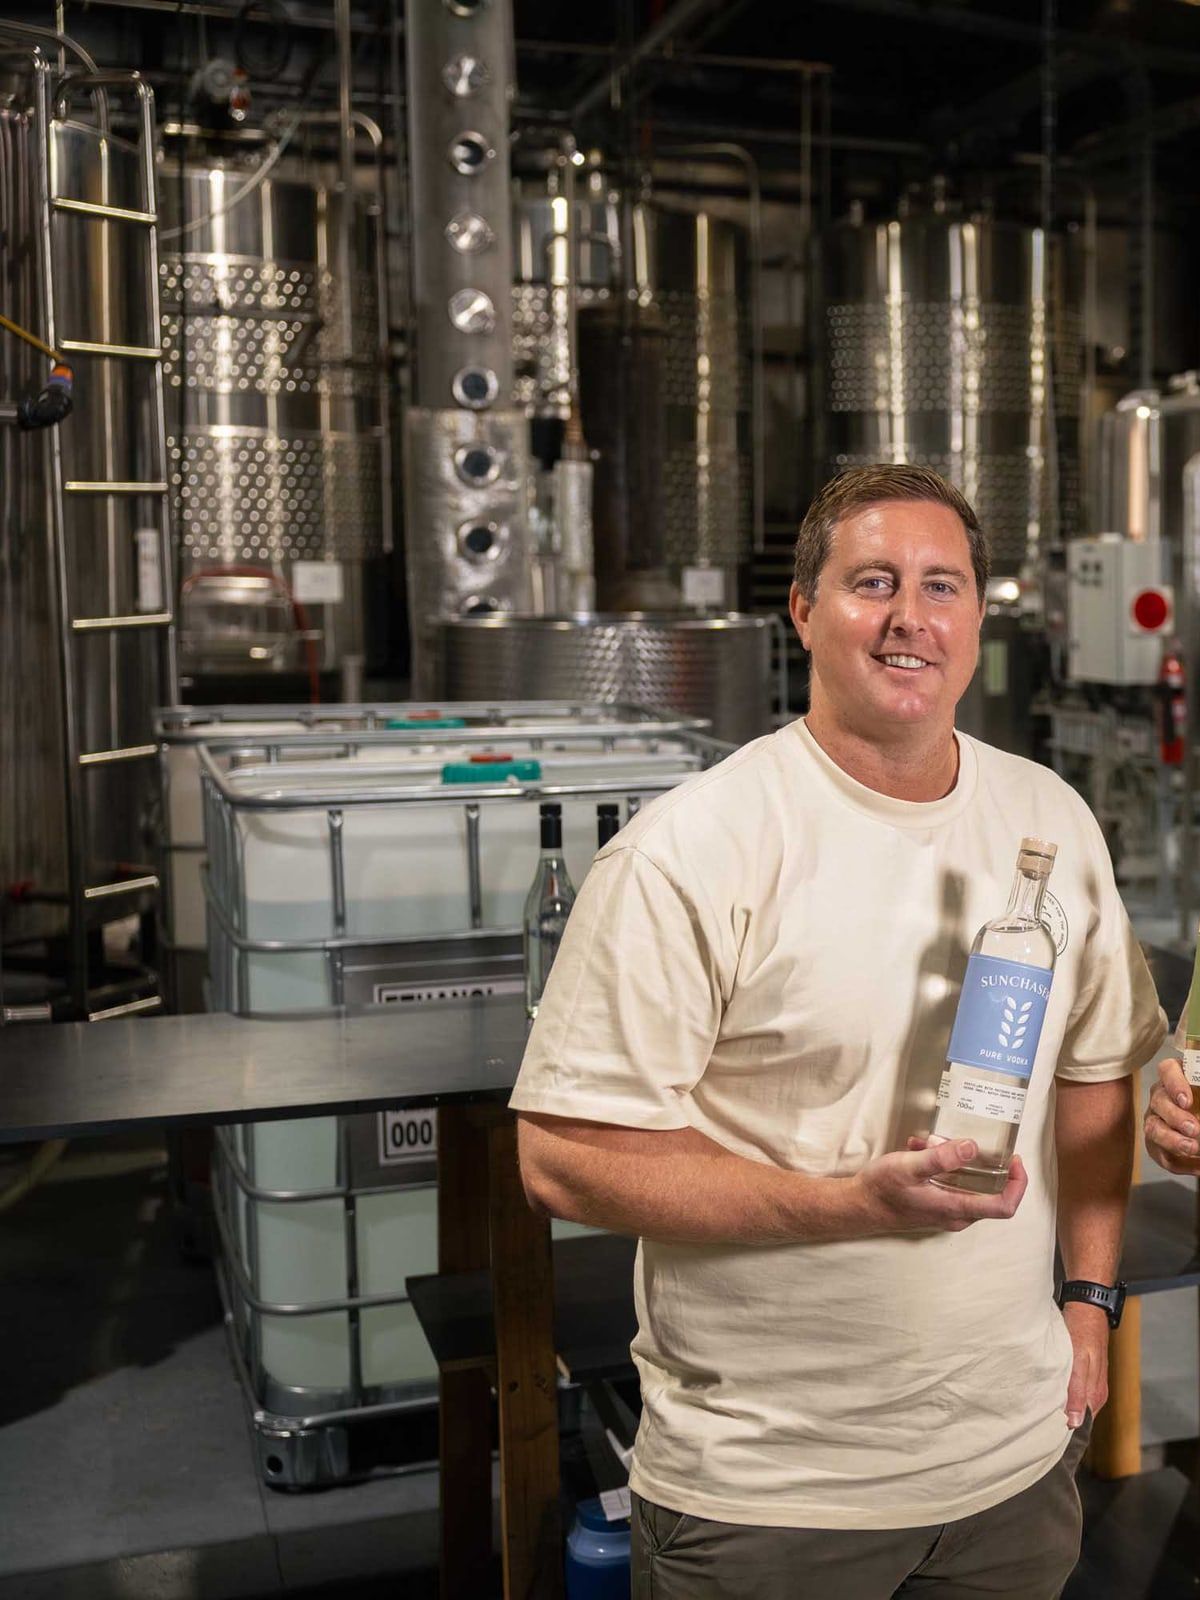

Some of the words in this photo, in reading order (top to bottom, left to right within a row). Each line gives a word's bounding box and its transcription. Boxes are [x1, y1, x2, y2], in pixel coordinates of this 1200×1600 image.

[980, 1048, 1002, 1060] PURE
[1007, 1055, 1028, 1066] VODKA
[392, 1120, 432, 1148] 000
